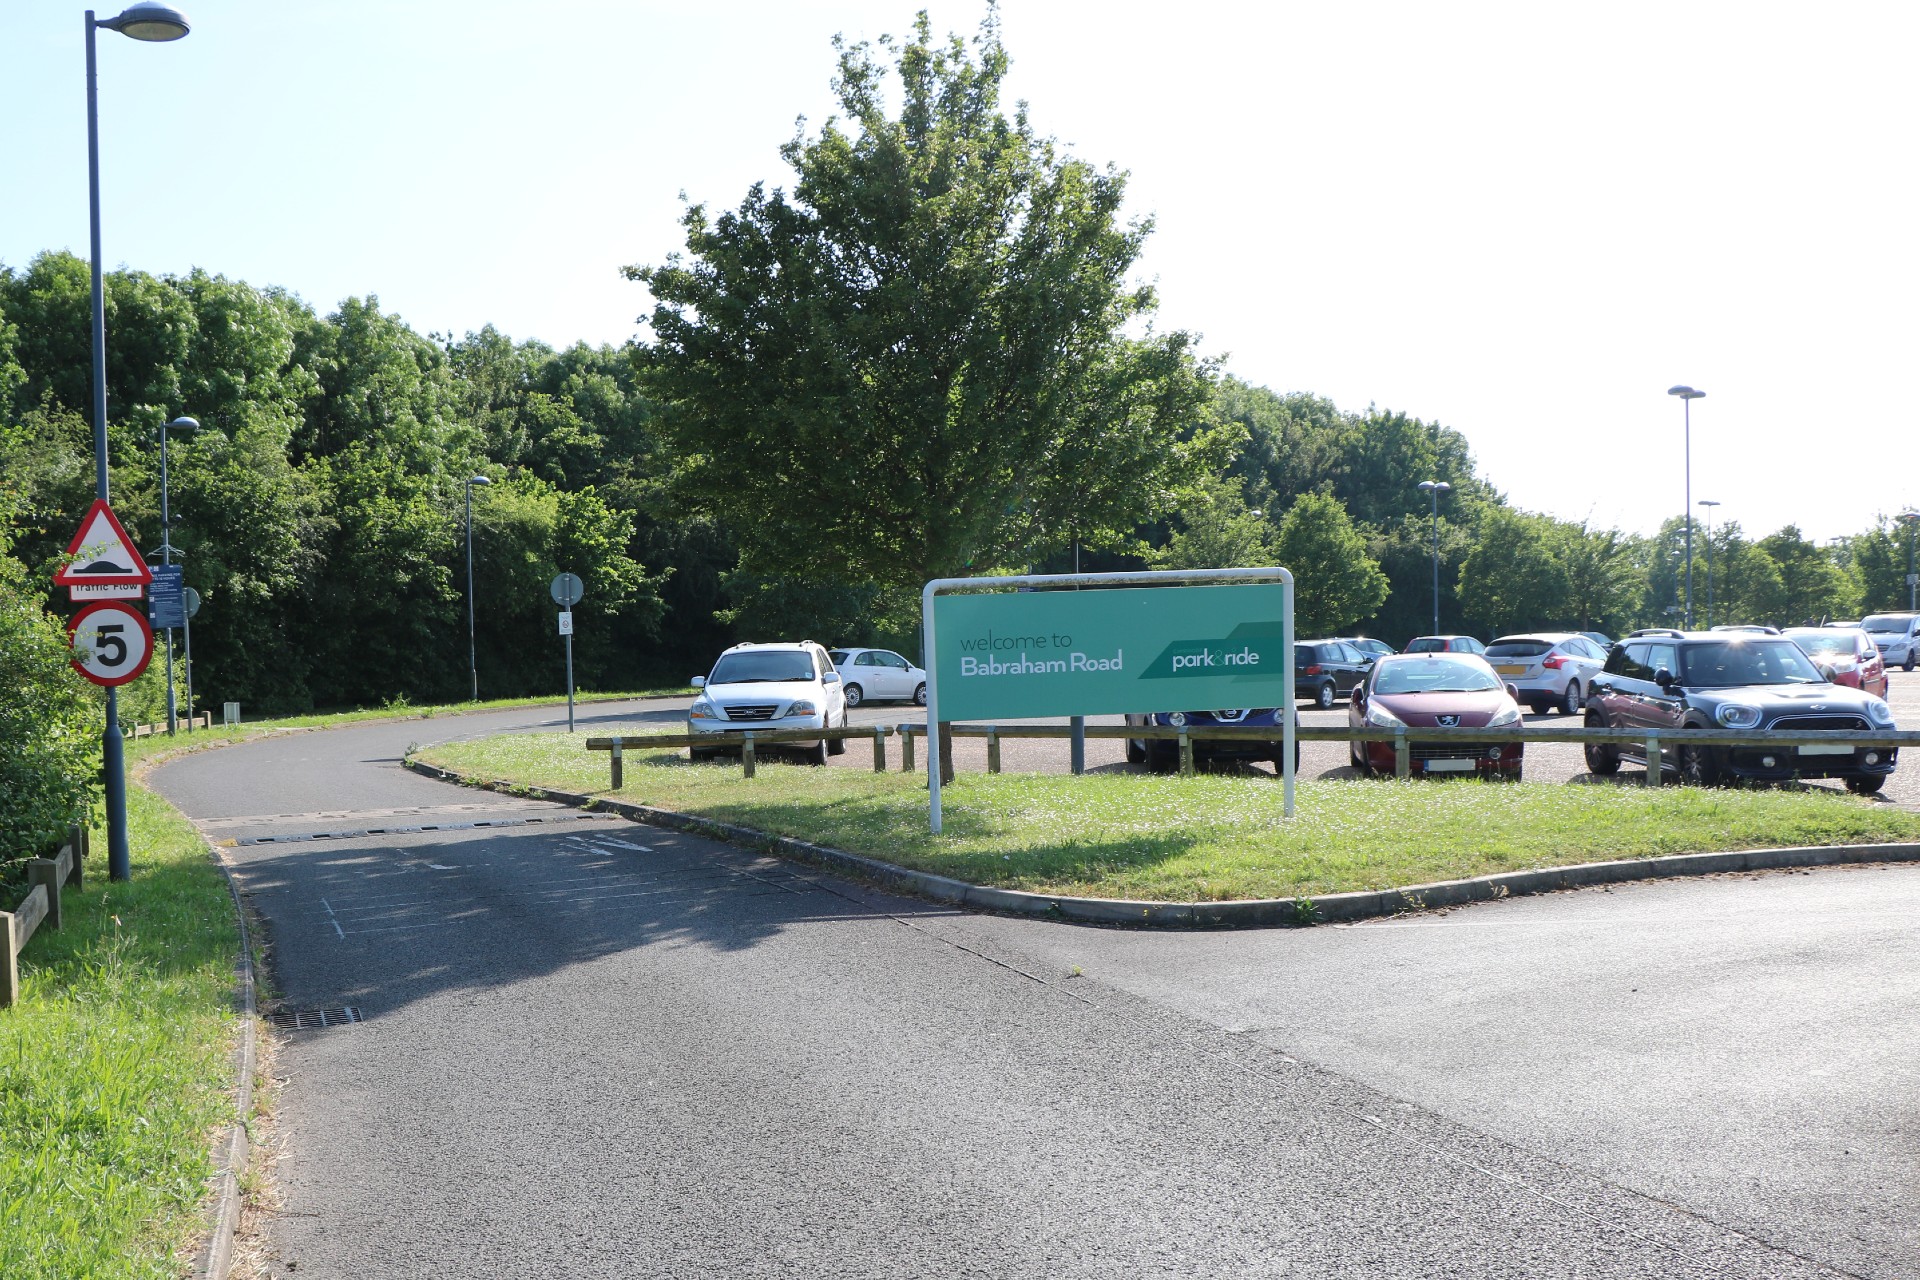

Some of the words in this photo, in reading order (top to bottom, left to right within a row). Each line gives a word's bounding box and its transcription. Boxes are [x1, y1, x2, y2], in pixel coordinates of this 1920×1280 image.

[113, 583, 138, 591] Flow
[96, 624, 127, 667] 5
[960, 629, 1047, 651] welcome
[1051, 633, 1072, 648] to
[961, 653, 1066, 676] Babraham
[1071, 649, 1123, 670] Road
